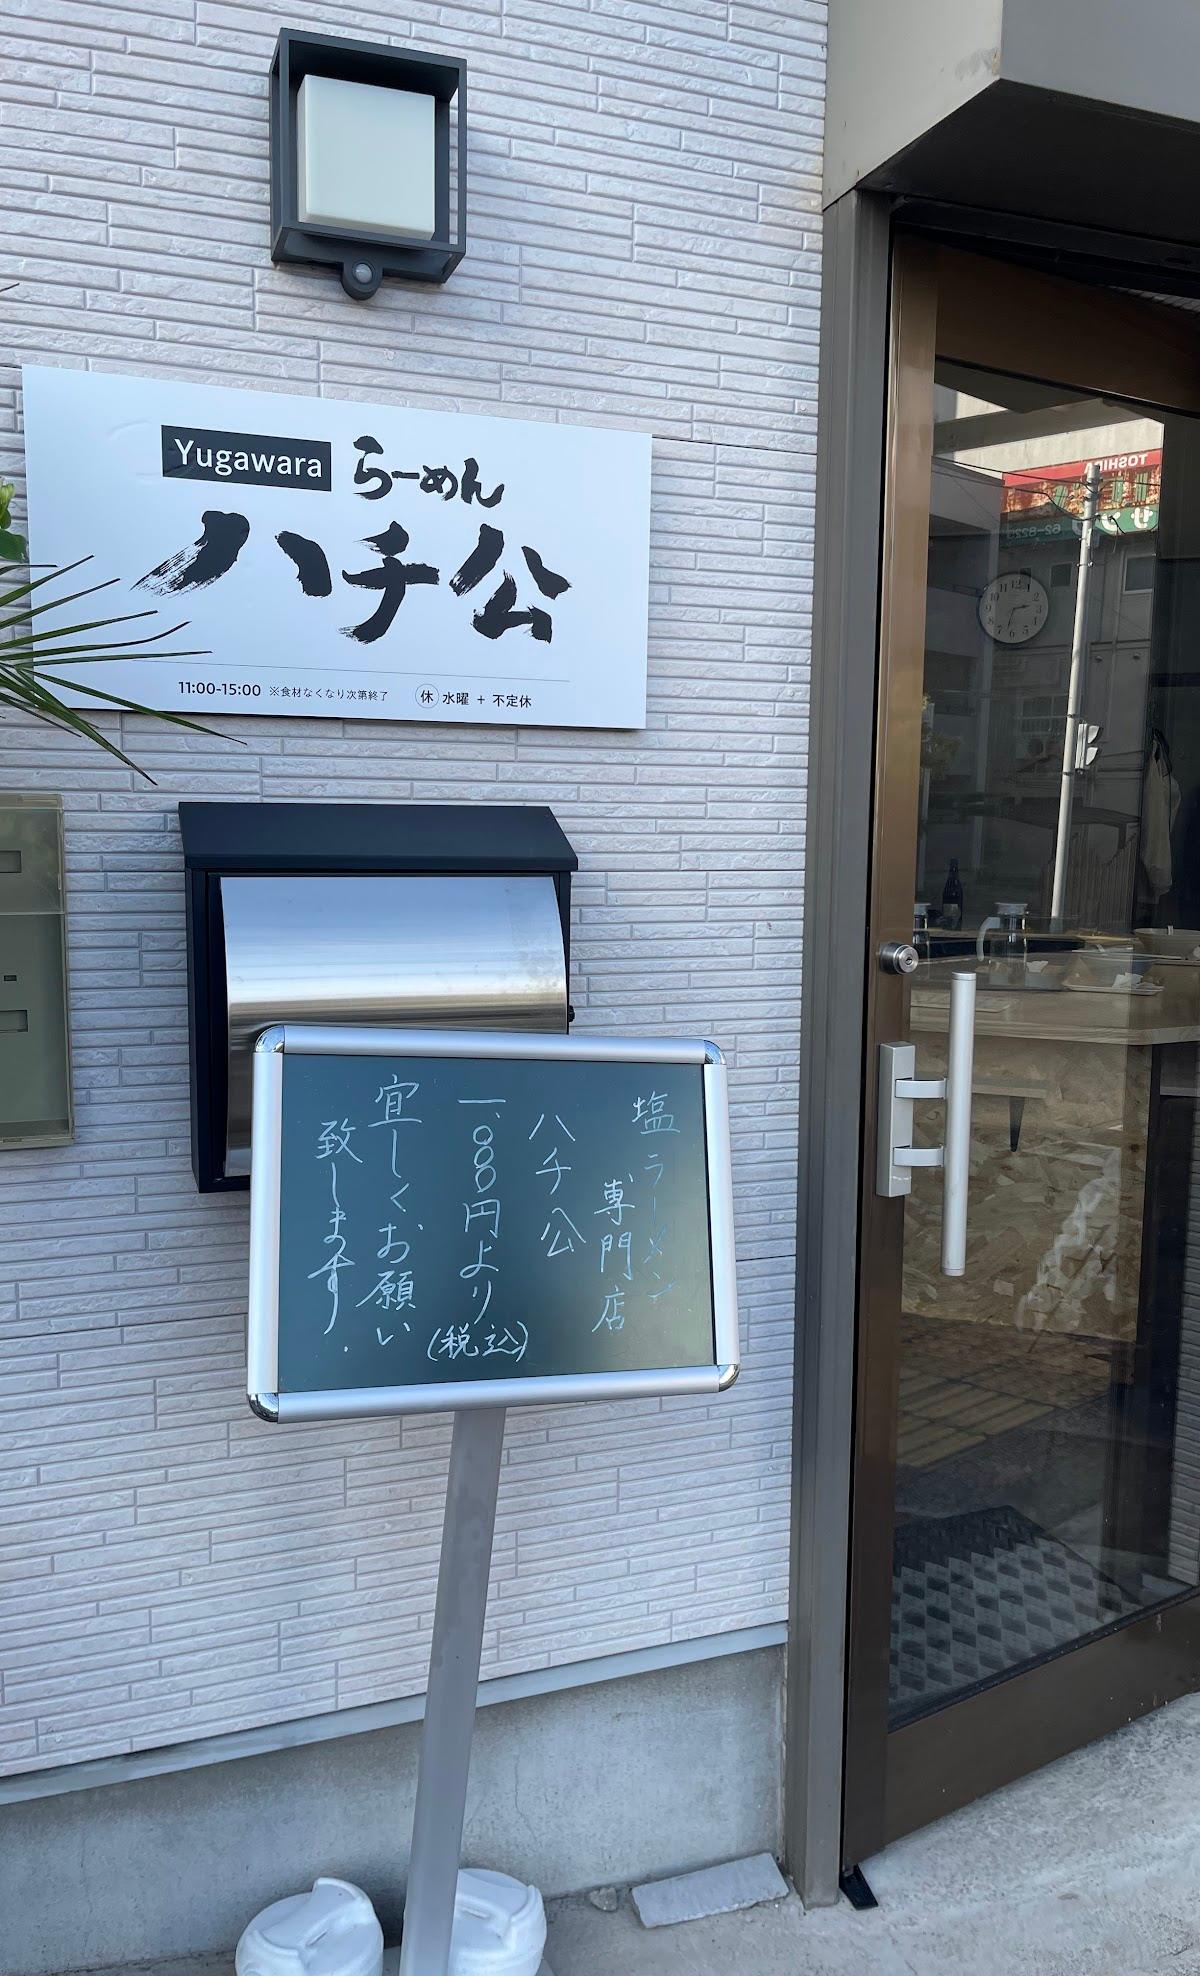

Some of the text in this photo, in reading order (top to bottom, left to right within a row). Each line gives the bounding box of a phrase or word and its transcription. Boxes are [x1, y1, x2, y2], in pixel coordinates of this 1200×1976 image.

[174, 437, 323, 478] Yugawara
[353, 434, 505, 508] らーめん
[129, 510, 573, 644] ハチ公
[178, 681, 262, 697] 11:00-15:00
[442, 691, 469, 706] 水曜
[492, 693, 532, 708] 不定休
[355, 1073, 424, 1346] 宜しくお願い
[528, 1113, 587, 1258] ハチ公
[591, 1172, 636, 1333] 専門店
[632, 1090, 681, 1303] 塩ラーメン
